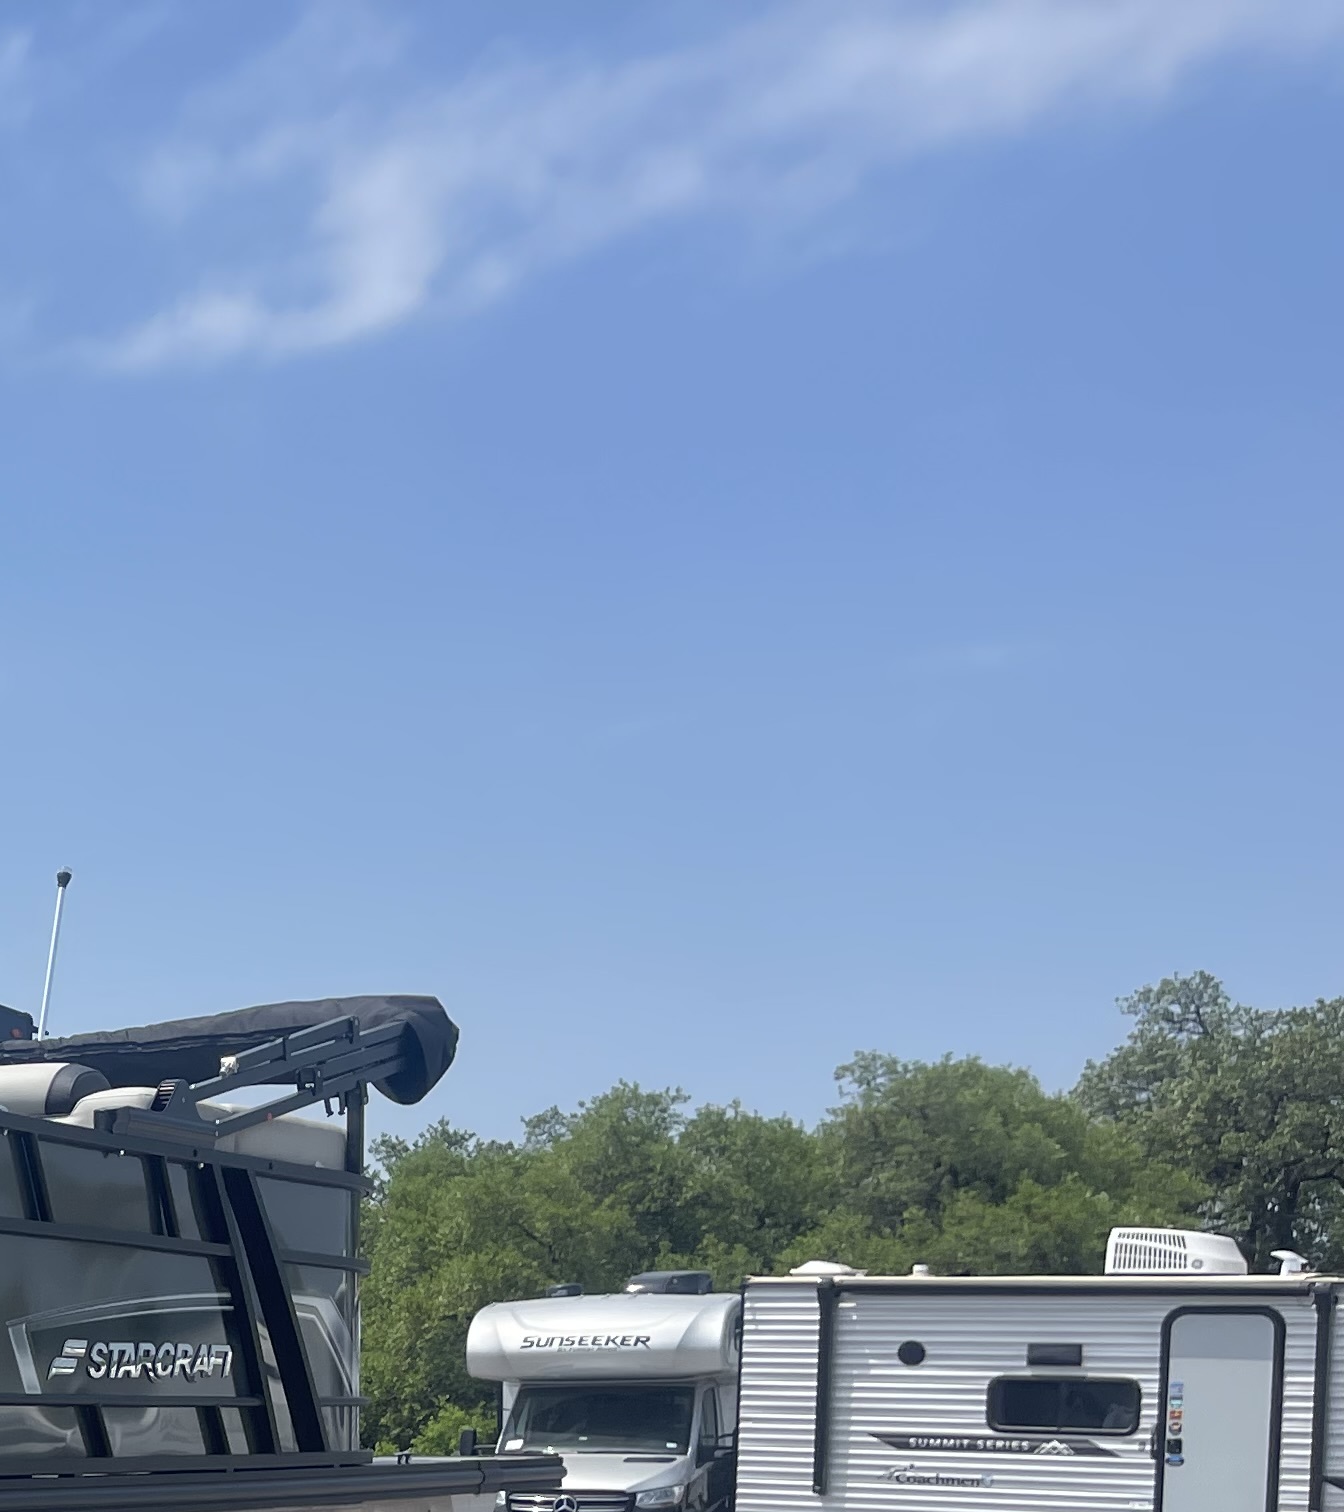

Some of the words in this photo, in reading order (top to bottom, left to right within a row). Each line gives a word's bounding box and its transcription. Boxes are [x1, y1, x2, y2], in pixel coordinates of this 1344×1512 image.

[520, 1335, 651, 1349] SUNSEEKER
[88, 1342, 232, 1381] STARCRAFT
[909, 1437, 970, 1448] SUMMIT
[976, 1439, 1030, 1451] SERIES
[895, 1472, 980, 1487] Coachmen
